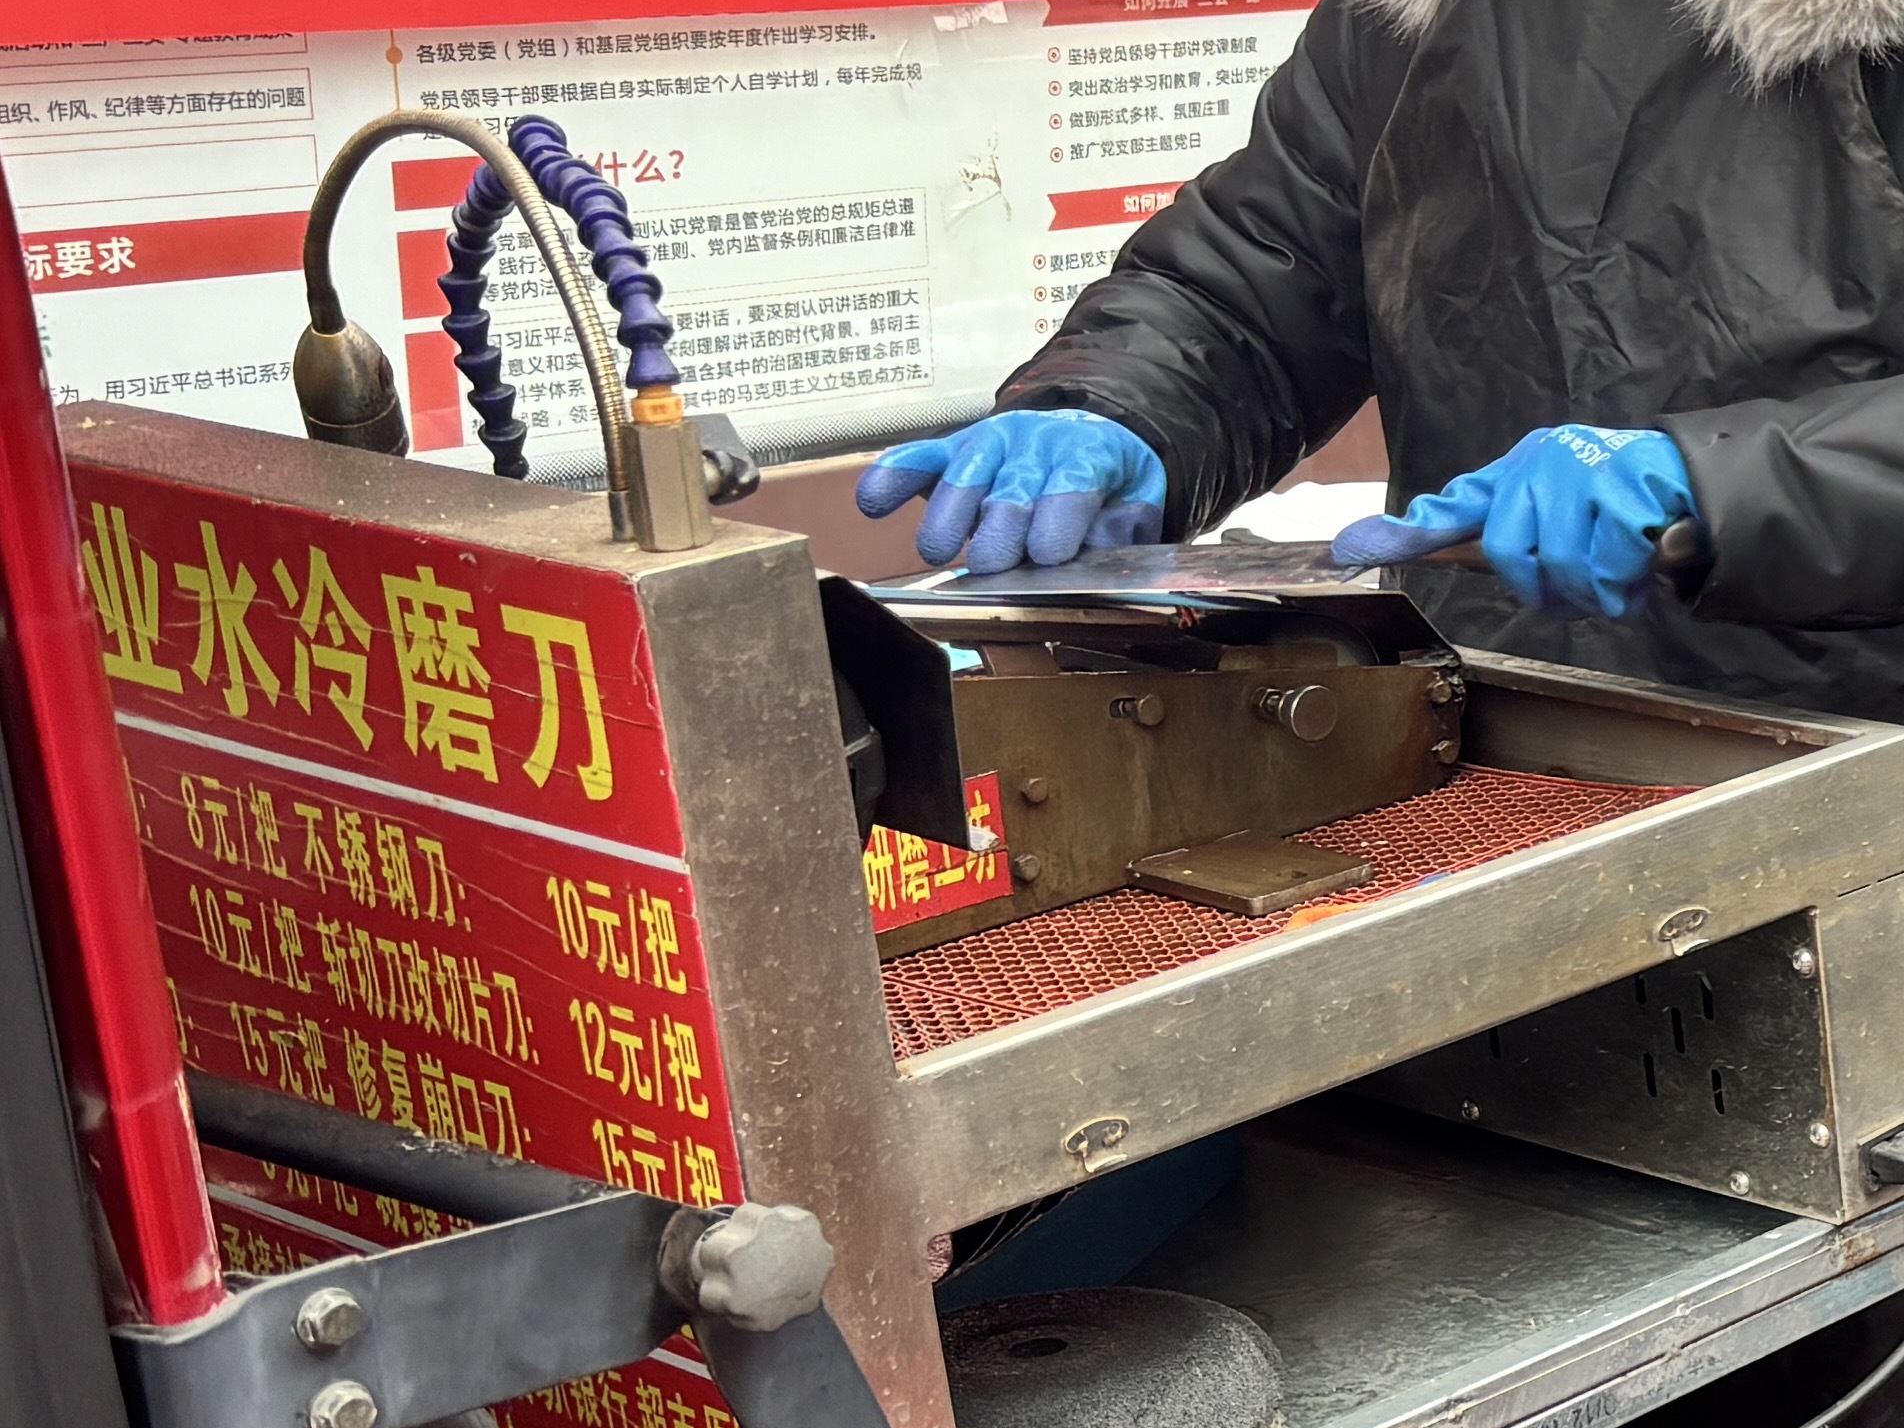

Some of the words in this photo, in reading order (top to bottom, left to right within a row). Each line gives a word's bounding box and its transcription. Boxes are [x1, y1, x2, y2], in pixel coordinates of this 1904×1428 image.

[82, 502, 613, 801] 业水冷磨刀
[181, 775, 288, 880] 8元/把
[546, 876, 688, 995] 10元/把
[190, 884, 313, 994] 10元/把
[568, 998, 710, 1120] 12元/把
